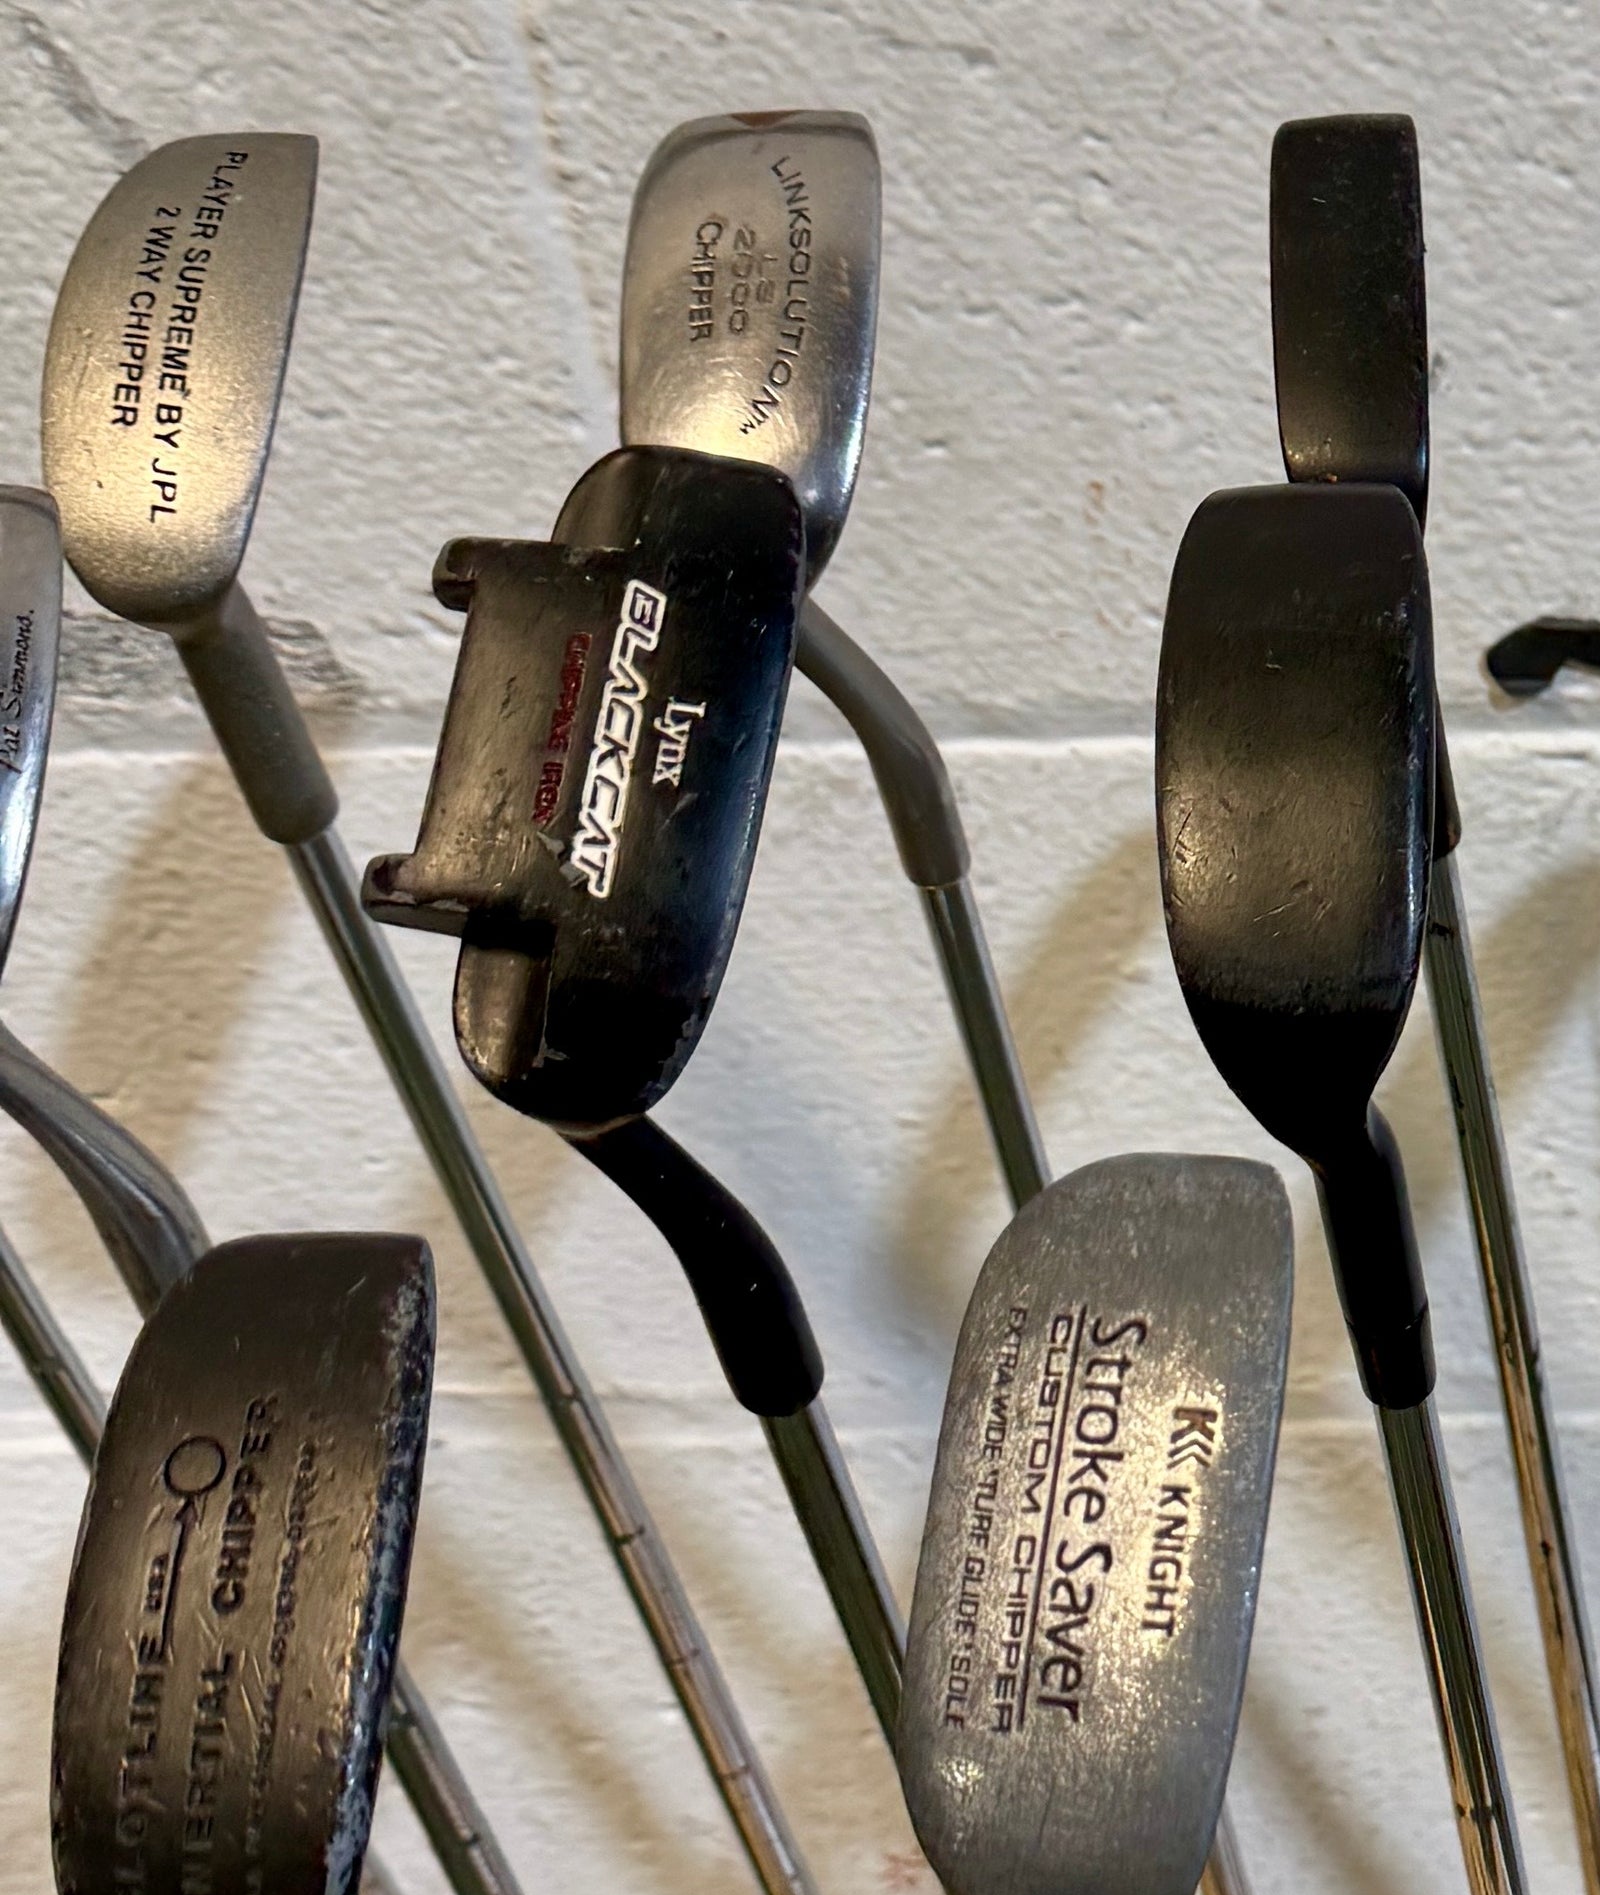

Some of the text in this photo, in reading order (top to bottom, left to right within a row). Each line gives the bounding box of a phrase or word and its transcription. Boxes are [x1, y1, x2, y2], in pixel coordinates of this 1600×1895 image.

[111, 206, 181, 427] 2 WAY CHIPPER
[149, 150, 248, 523] PLAYER SUPREME BY JPL
[688, 221, 723, 342] CHIPPER
[728, 225, 756, 335] 2000
[570, 579, 667, 898] BLACKCAT
[652, 696, 706, 788] Lynx
[995, 1306, 1028, 1386] EXTRA
[981, 1391, 1018, 1464] WIDE
[211, 1395, 279, 1618] CHIPPER
[991, 1313, 1076, 1735] CUSTOM CHIPPER
[1036, 1315, 1149, 1724] Stroke Saver
[1141, 1483, 1193, 1637] KNIGHT
[945, 1653, 972, 1732] SOLE
